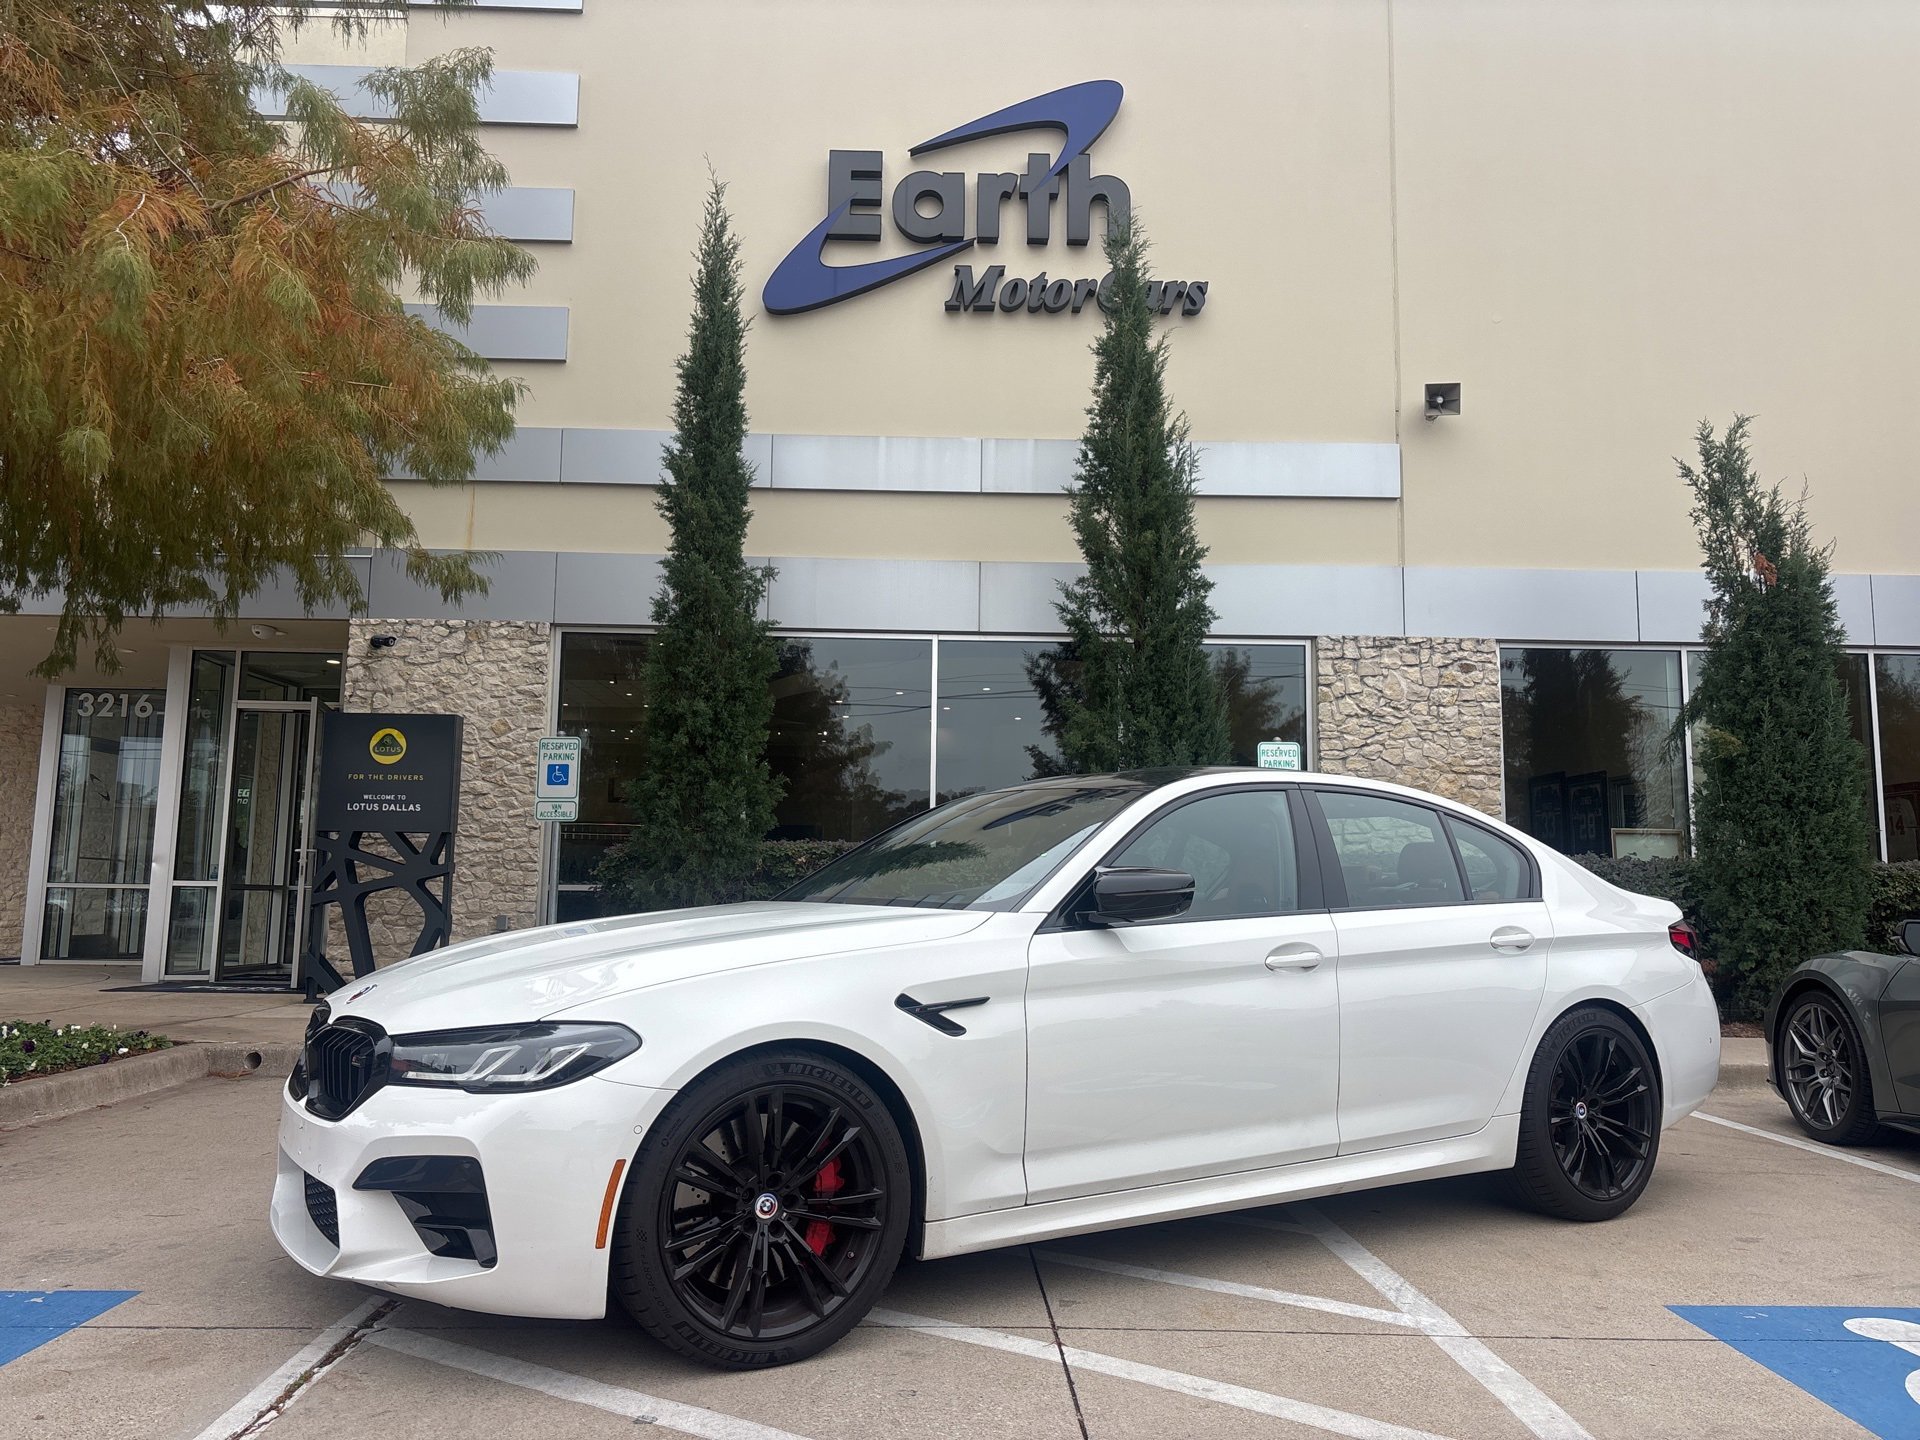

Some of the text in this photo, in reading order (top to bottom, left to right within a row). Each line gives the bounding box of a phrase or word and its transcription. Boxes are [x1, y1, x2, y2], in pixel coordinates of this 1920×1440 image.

[828, 150, 1132, 246] Earth
[77, 692, 154, 718] 3216
[541, 742, 578, 751] RESERVED
[543, 753, 575, 761] PARKING
[1261, 749, 1297, 757] RESERVED
[1264, 760, 1296, 768] PARKING
[347, 803, 421, 812] LOTUS DALLAS
[539, 810, 573, 818] ACCESSIBLE
[787, 1063, 873, 1109] MICHELIN
